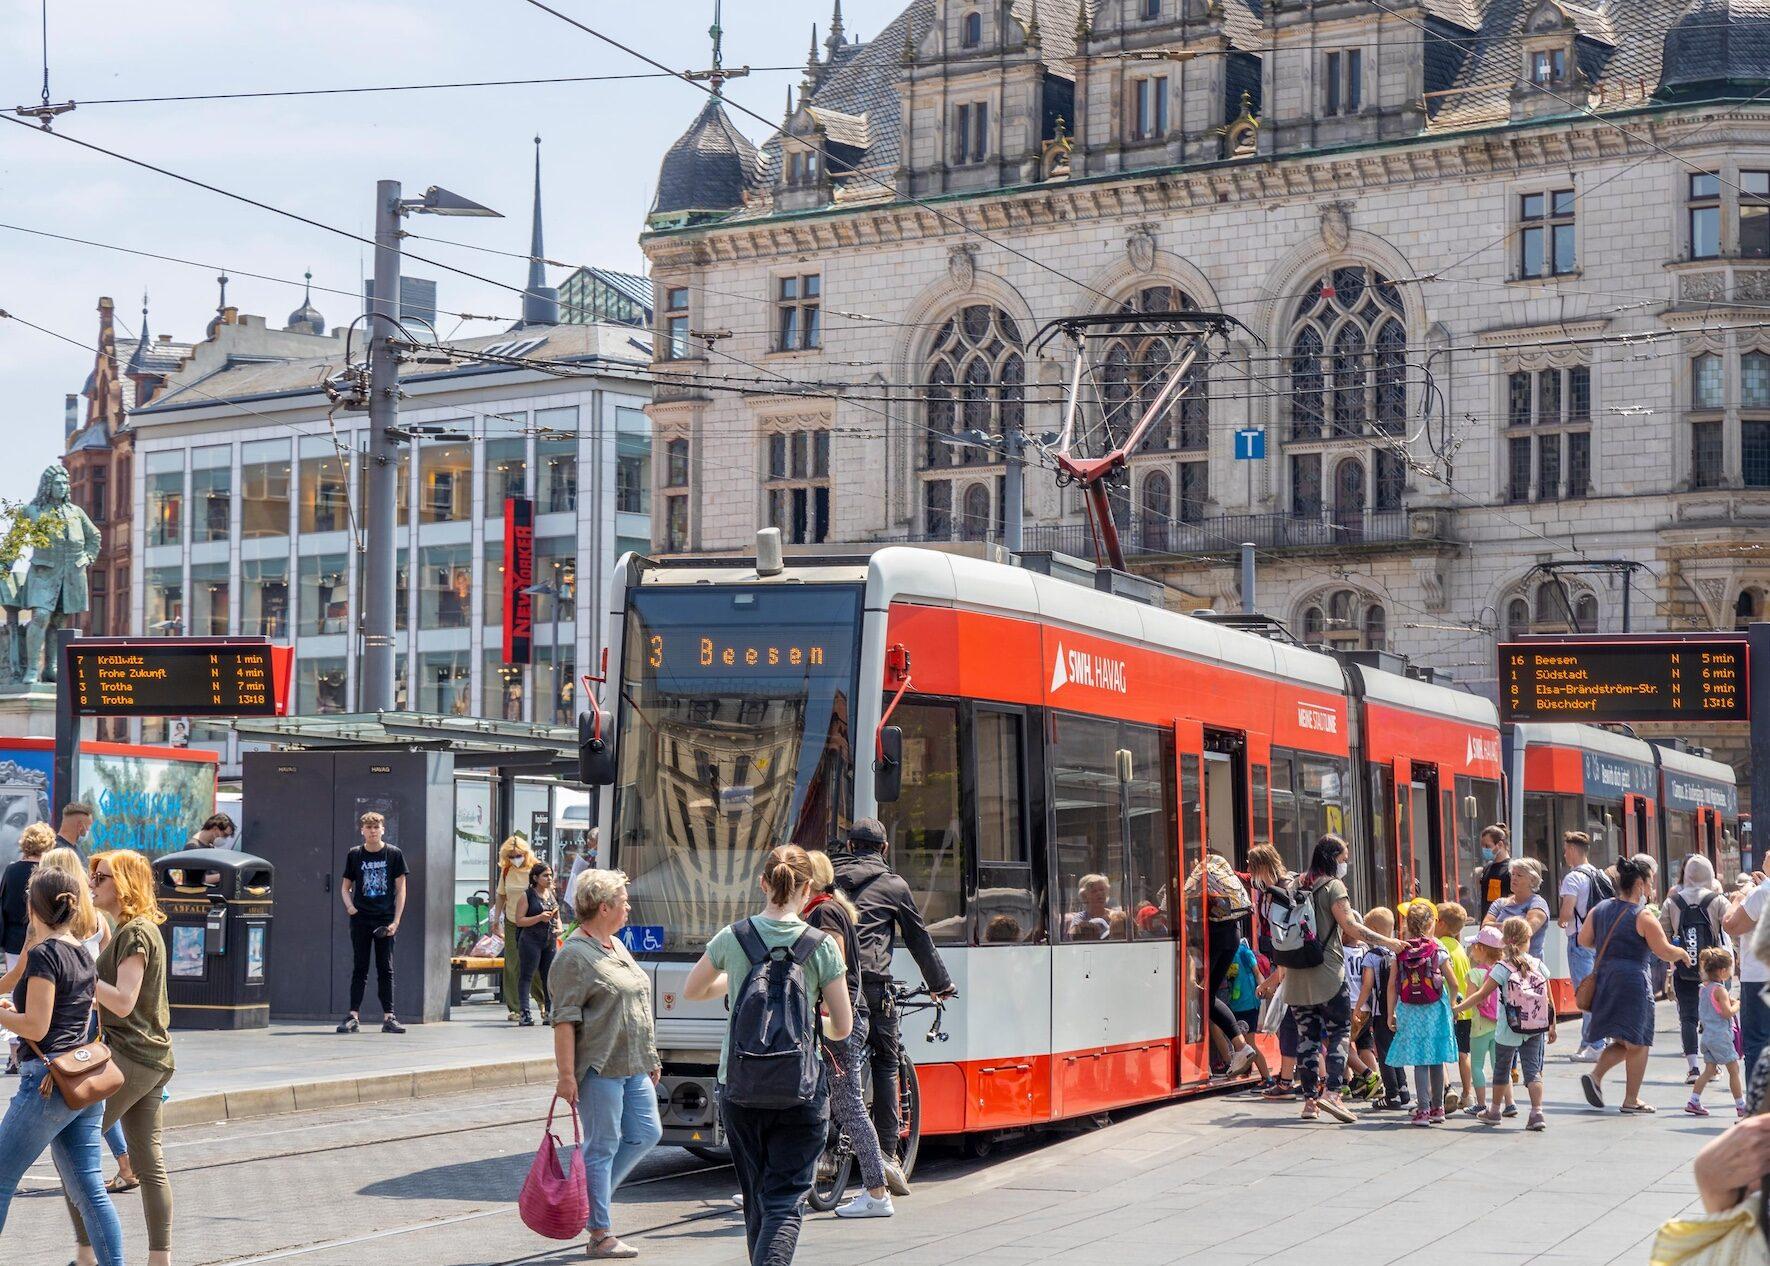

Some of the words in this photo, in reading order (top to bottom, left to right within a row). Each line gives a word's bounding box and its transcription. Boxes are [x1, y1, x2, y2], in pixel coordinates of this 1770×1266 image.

[1240, 431, 1259, 457] T
[650, 635, 662, 667] 3
[701, 638, 823, 666] Beesen
[77, 656, 84, 664] 7
[98, 655, 144, 664] Kröllwitz
[211, 655, 218, 664] N
[236, 655, 242, 664] 1
[245, 655, 263, 664] min
[1511, 655, 1524, 665] 16
[1535, 655, 1577, 665] Beesen
[1672, 654, 1679, 663] N
[1702, 654, 1709, 663] 5
[1713, 654, 1734, 663] min
[79, 670, 84, 678] 1
[99, 669, 125, 678] Frohe
[130, 669, 167, 679] Zukunft
[212, 669, 219, 677] N
[237, 669, 243, 677] 4
[245, 669, 264, 677] min
[1068, 649, 1094, 687] SWH.
[1095, 656, 1126, 693] HAVAG
[1512, 670, 1517, 679] 1
[1535, 669, 1588, 680] Südstadt
[1672, 669, 1680, 678] N
[1703, 669, 1710, 678] 6
[1713, 669, 1735, 678] min
[80, 683, 86, 692] 3
[100, 682, 132, 691] Trotha
[213, 682, 220, 690] N
[238, 682, 244, 690] 7
[246, 682, 265, 691] min
[1511, 685, 1518, 694] 8
[1536, 684, 1658, 694] Elsa-Brändström-Str.
[1672, 684, 1680, 693] N
[1703, 684, 1710, 693] 9
[1713, 684, 1735, 693] min
[80, 696, 87, 705] 8
[102, 696, 133, 705] Trotha
[214, 696, 221, 704] N
[238, 695, 265, 704] 13:18
[1512, 700, 1519, 709] 7
[1536, 699, 1596, 711] Büschdorf
[1673, 699, 1680, 708] N
[1703, 699, 1734, 708] 13:16
[1686, 927, 1698, 966] adidas
